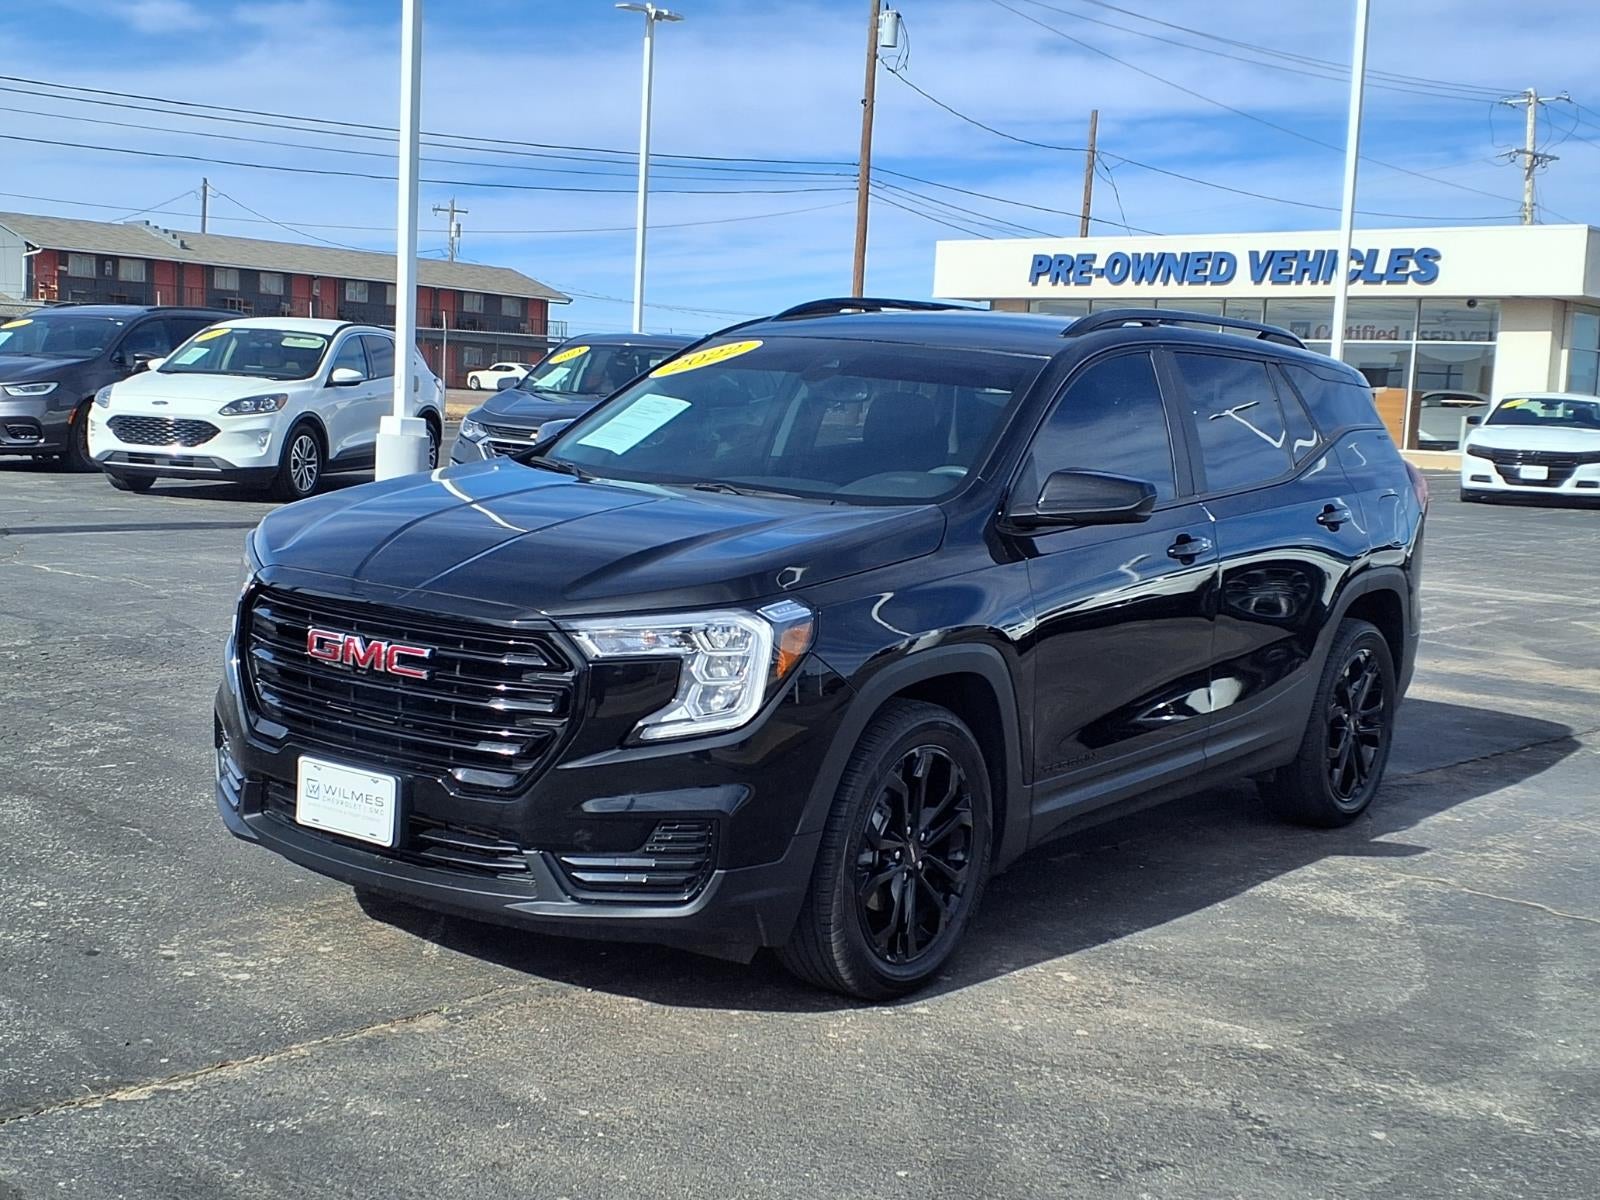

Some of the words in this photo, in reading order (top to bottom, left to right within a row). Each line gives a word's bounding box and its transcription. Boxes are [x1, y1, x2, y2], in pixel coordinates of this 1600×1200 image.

[1029, 252, 1238, 286] PRE-OWNED
[1314, 324, 1400, 340] Ctified
[306, 628, 433, 680] GMC
[323, 783, 385, 807] WILMES
